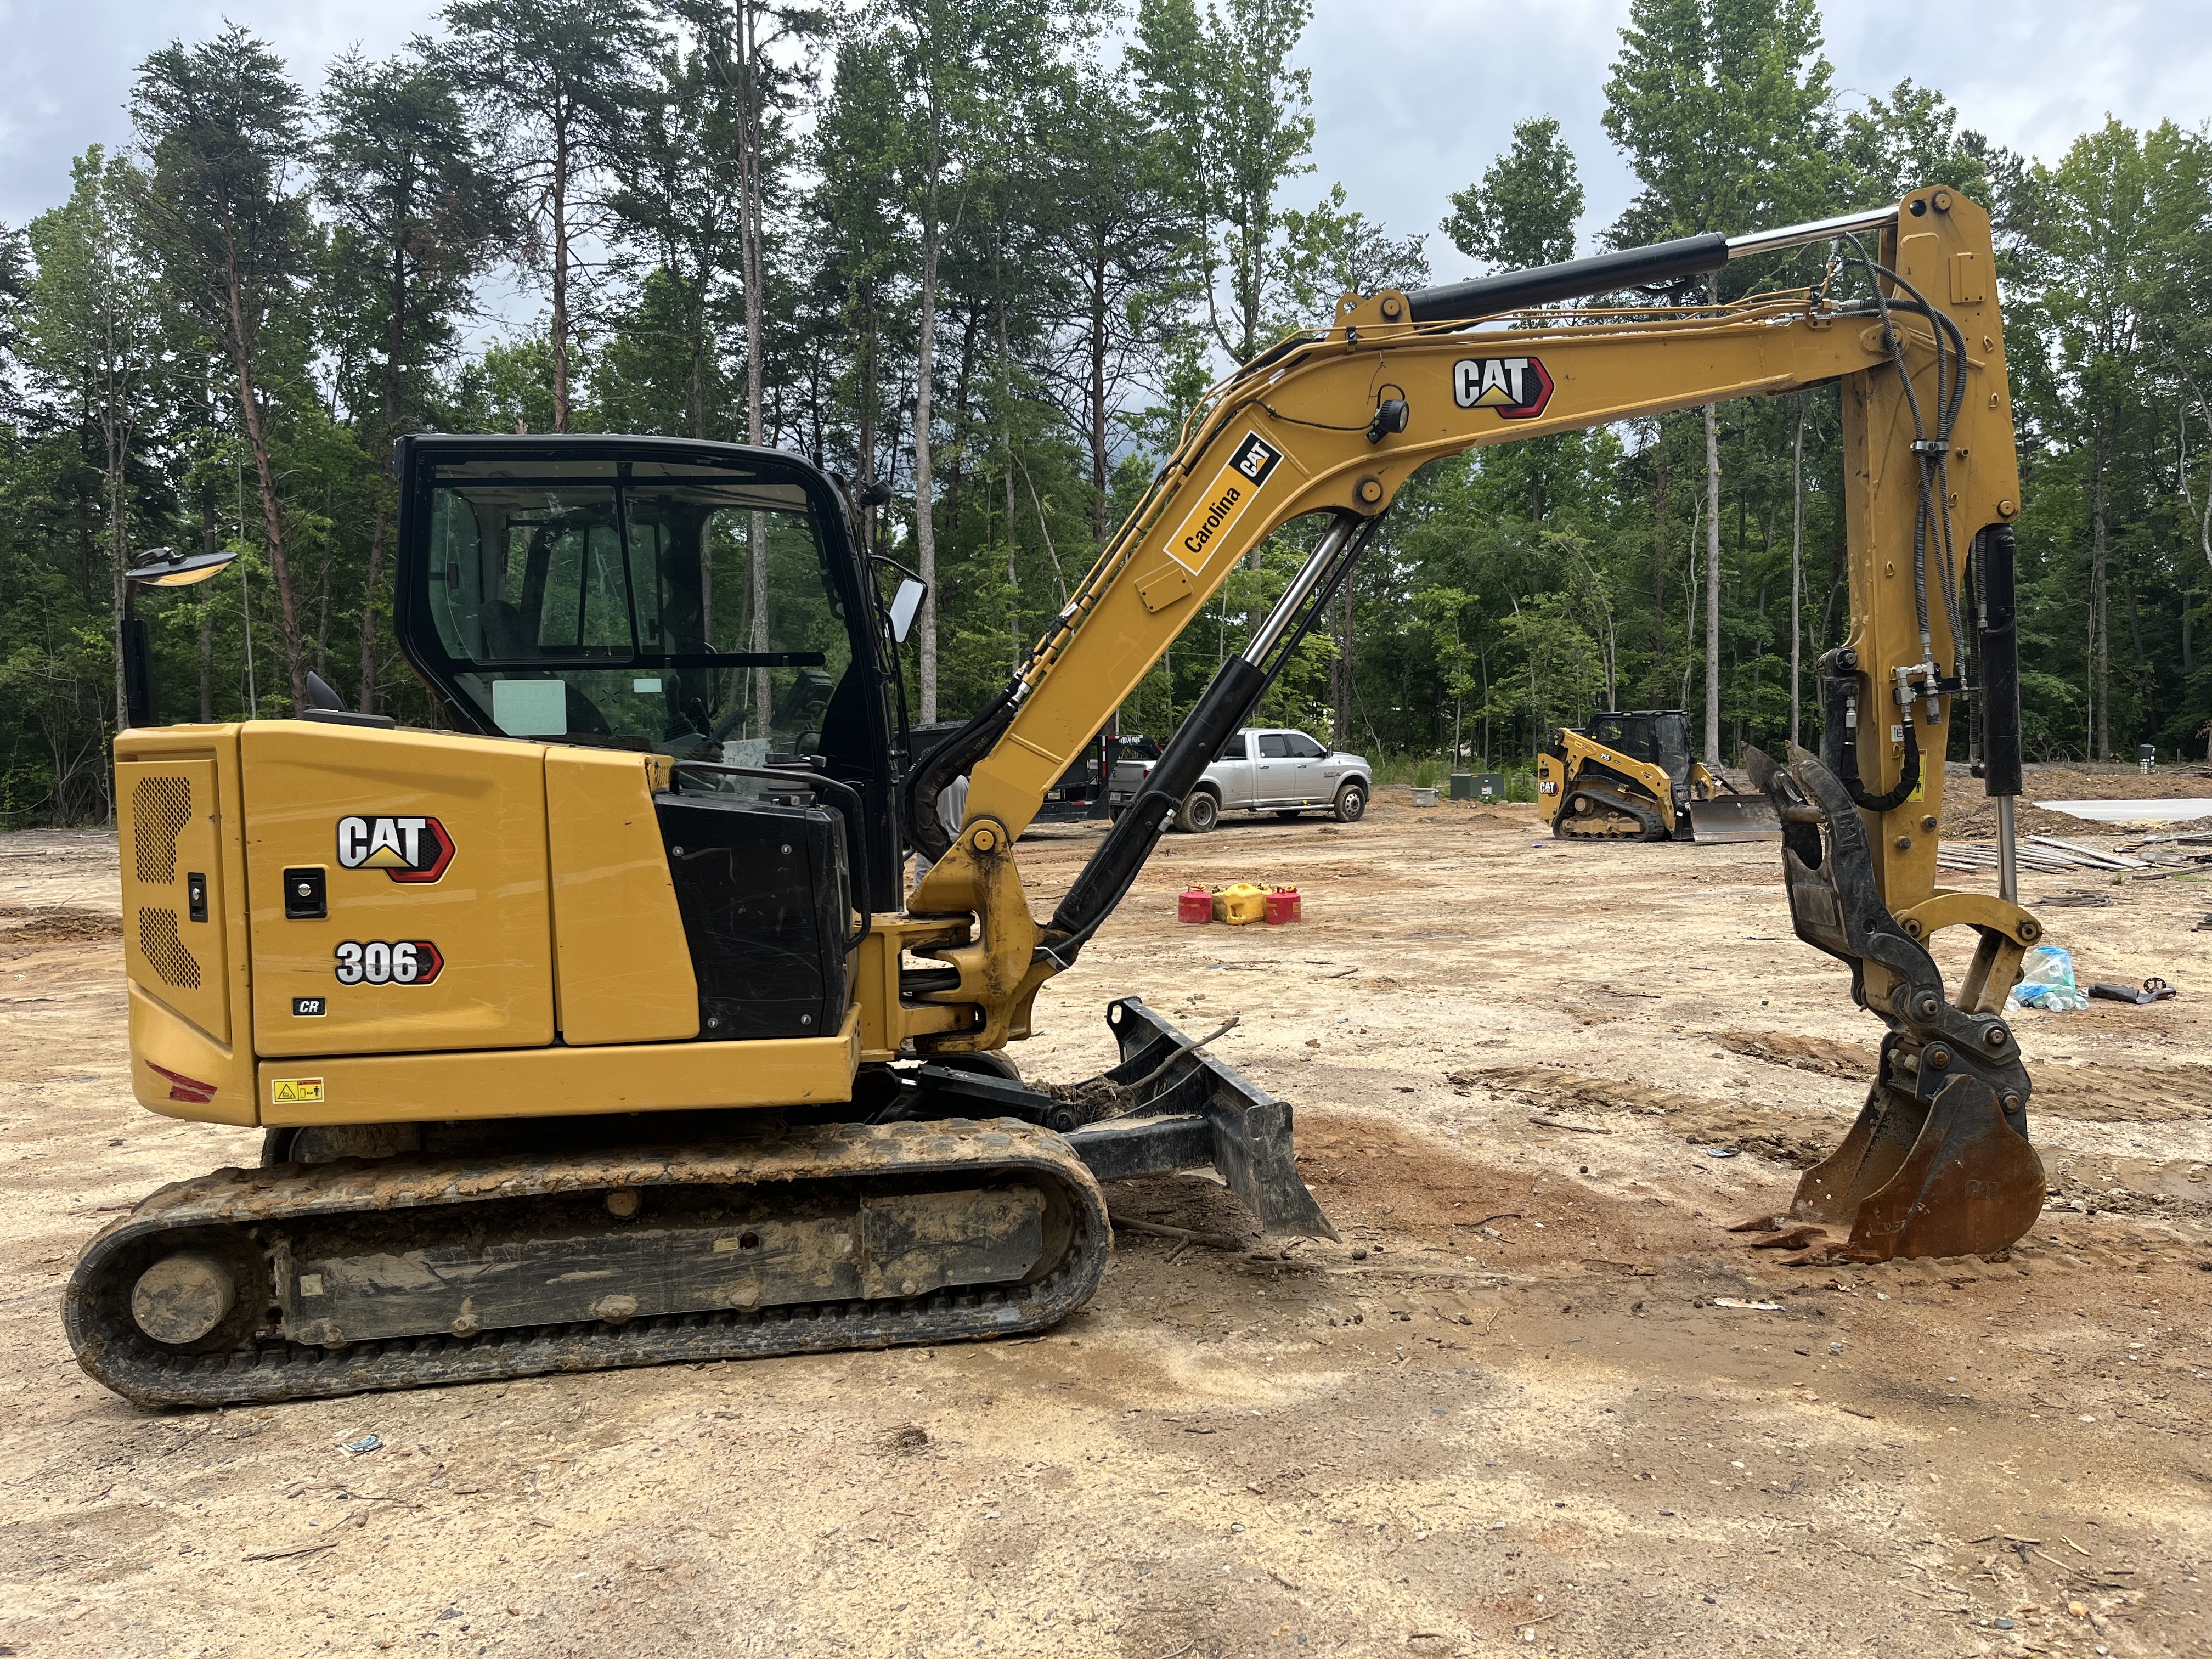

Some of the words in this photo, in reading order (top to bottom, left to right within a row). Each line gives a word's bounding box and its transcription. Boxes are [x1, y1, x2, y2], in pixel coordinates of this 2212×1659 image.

[1455, 358, 1528, 407] CAT
[1240, 442, 1270, 477] CAT
[1184, 487, 1242, 553] Carolina
[1600, 753, 1610, 761] 255
[1540, 782, 1555, 793] CAT
[339, 817, 426, 867] CAT
[337, 943, 418, 983] 306
[299, 1000, 319, 1013] CR
